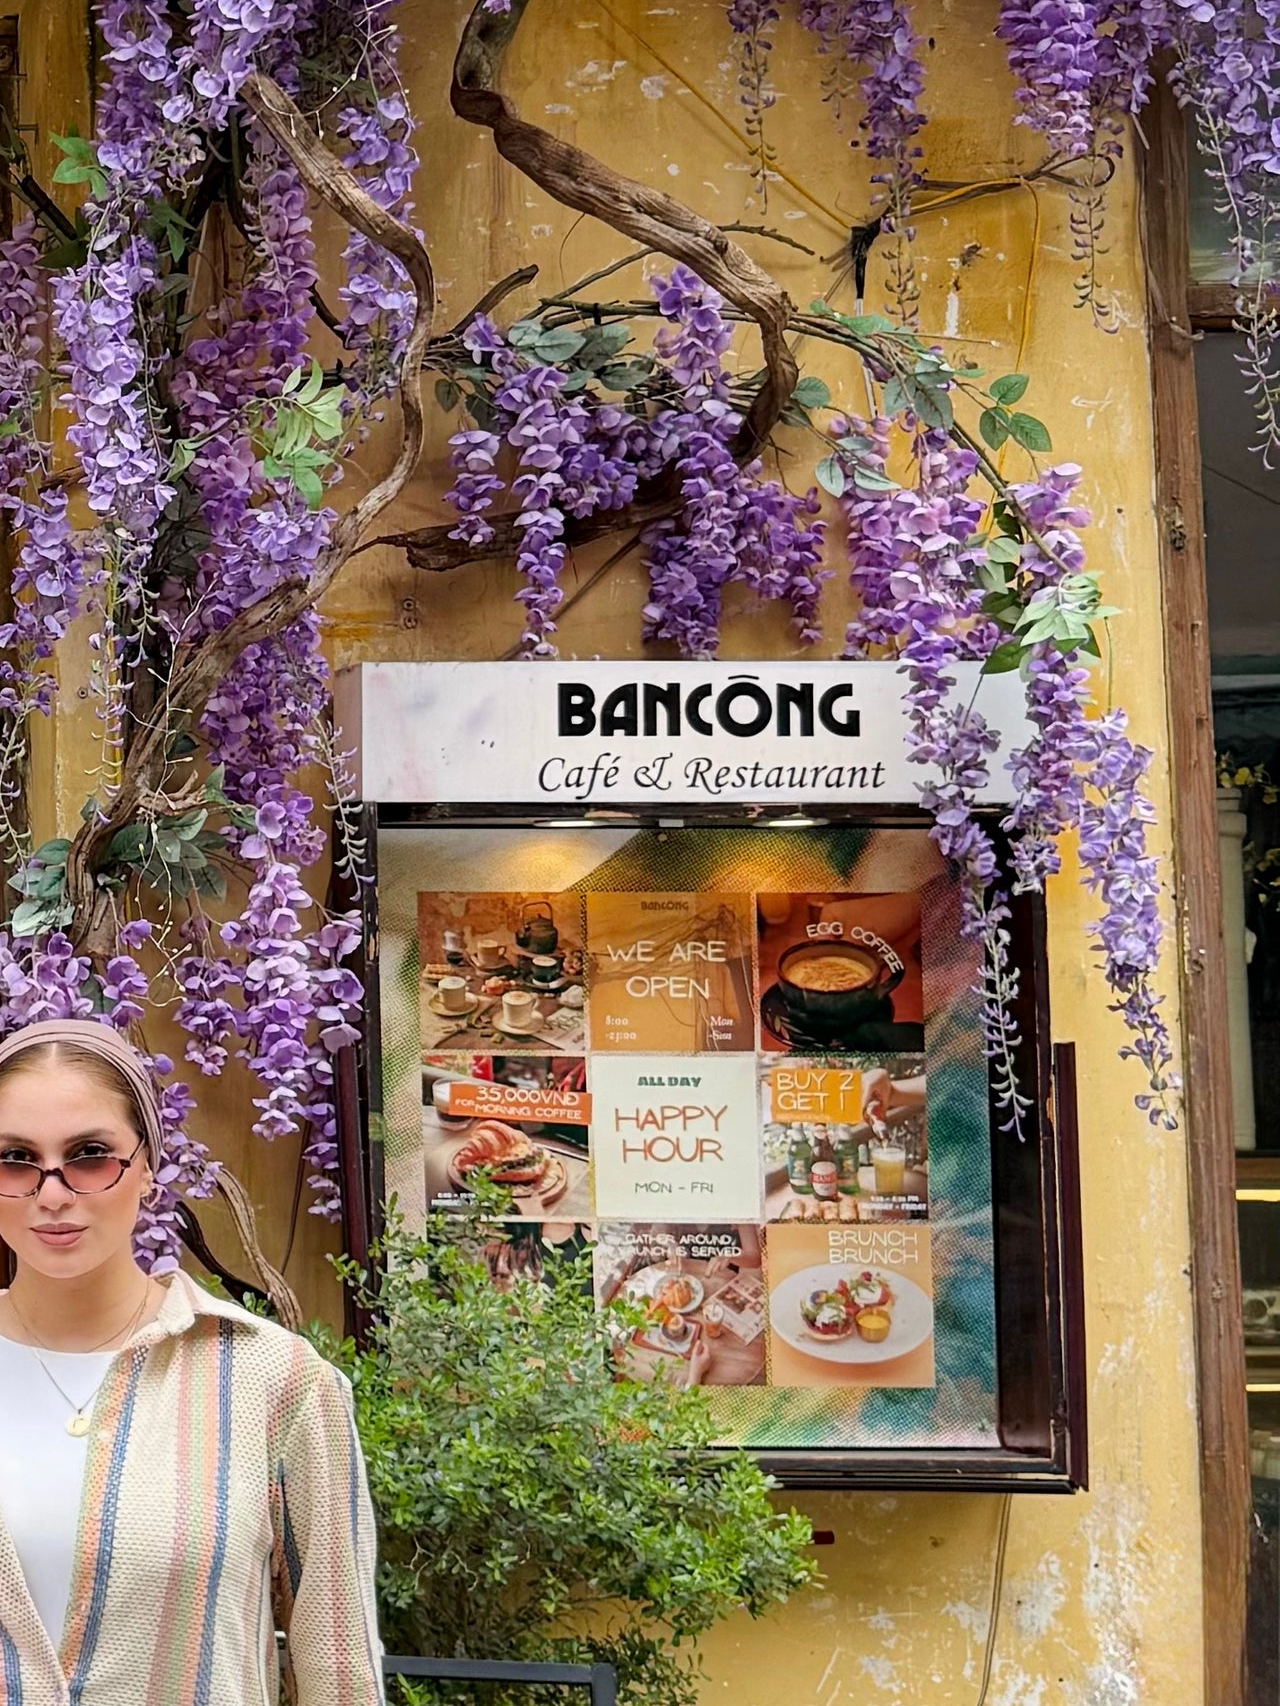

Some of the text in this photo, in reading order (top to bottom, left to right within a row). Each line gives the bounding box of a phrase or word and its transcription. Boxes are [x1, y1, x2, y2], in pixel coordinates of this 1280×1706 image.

[557, 675, 861, 738] BANCÔNG
[539, 752, 886, 800] Café & Restaurant
[607, 940, 726, 962] WE ARE
[806, 921, 904, 973] EGG COFFEE
[625, 975, 710, 999] OPEN
[710, 1015, 733, 1026] Mon
[637, 1076, 702, 1087] ALL DAY
[776, 1071, 855, 1091] BUY 2
[454, 1098, 582, 1120] FOR MORNING COFFEE
[777, 1092, 830, 1111] GET
[614, 1104, 728, 1132] HAPPY
[622, 1136, 724, 1164] HOUR
[634, 1181, 714, 1194] MON FRI
[625, 1233, 676, 1245] GATHER
[828, 1230, 918, 1247] BRUNCH
[691, 1246, 742, 1257] SERVED
[829, 1248, 918, 1265] BRUNCH
